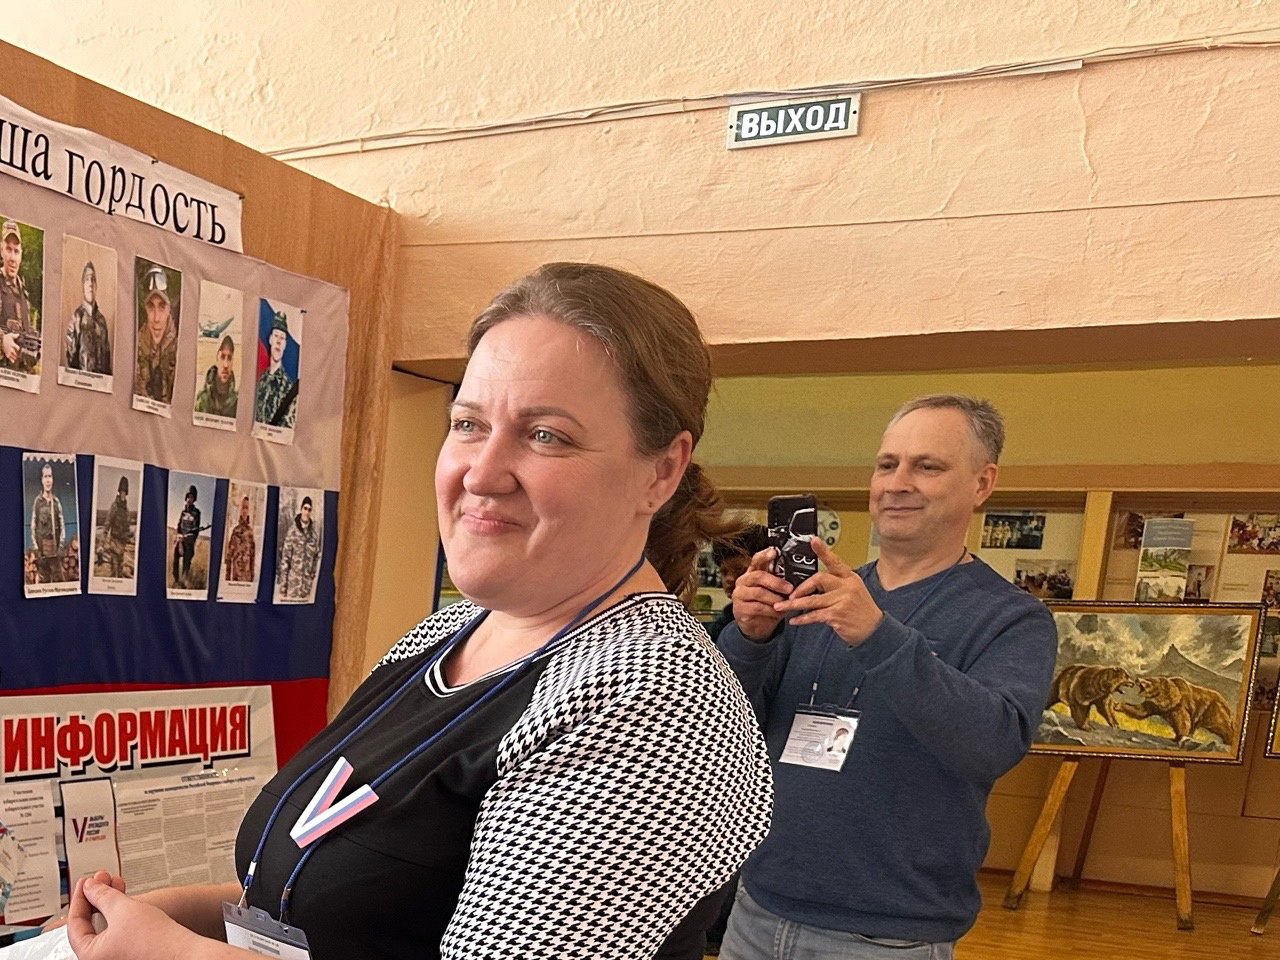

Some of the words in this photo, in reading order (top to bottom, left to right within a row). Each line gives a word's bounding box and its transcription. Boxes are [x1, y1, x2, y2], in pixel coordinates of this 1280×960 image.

[741, 102, 847, 139] ВЫХОД
[64, 148, 227, 245] гордость
[2, 703, 252, 775] ИНФОРМАЦИЯ
